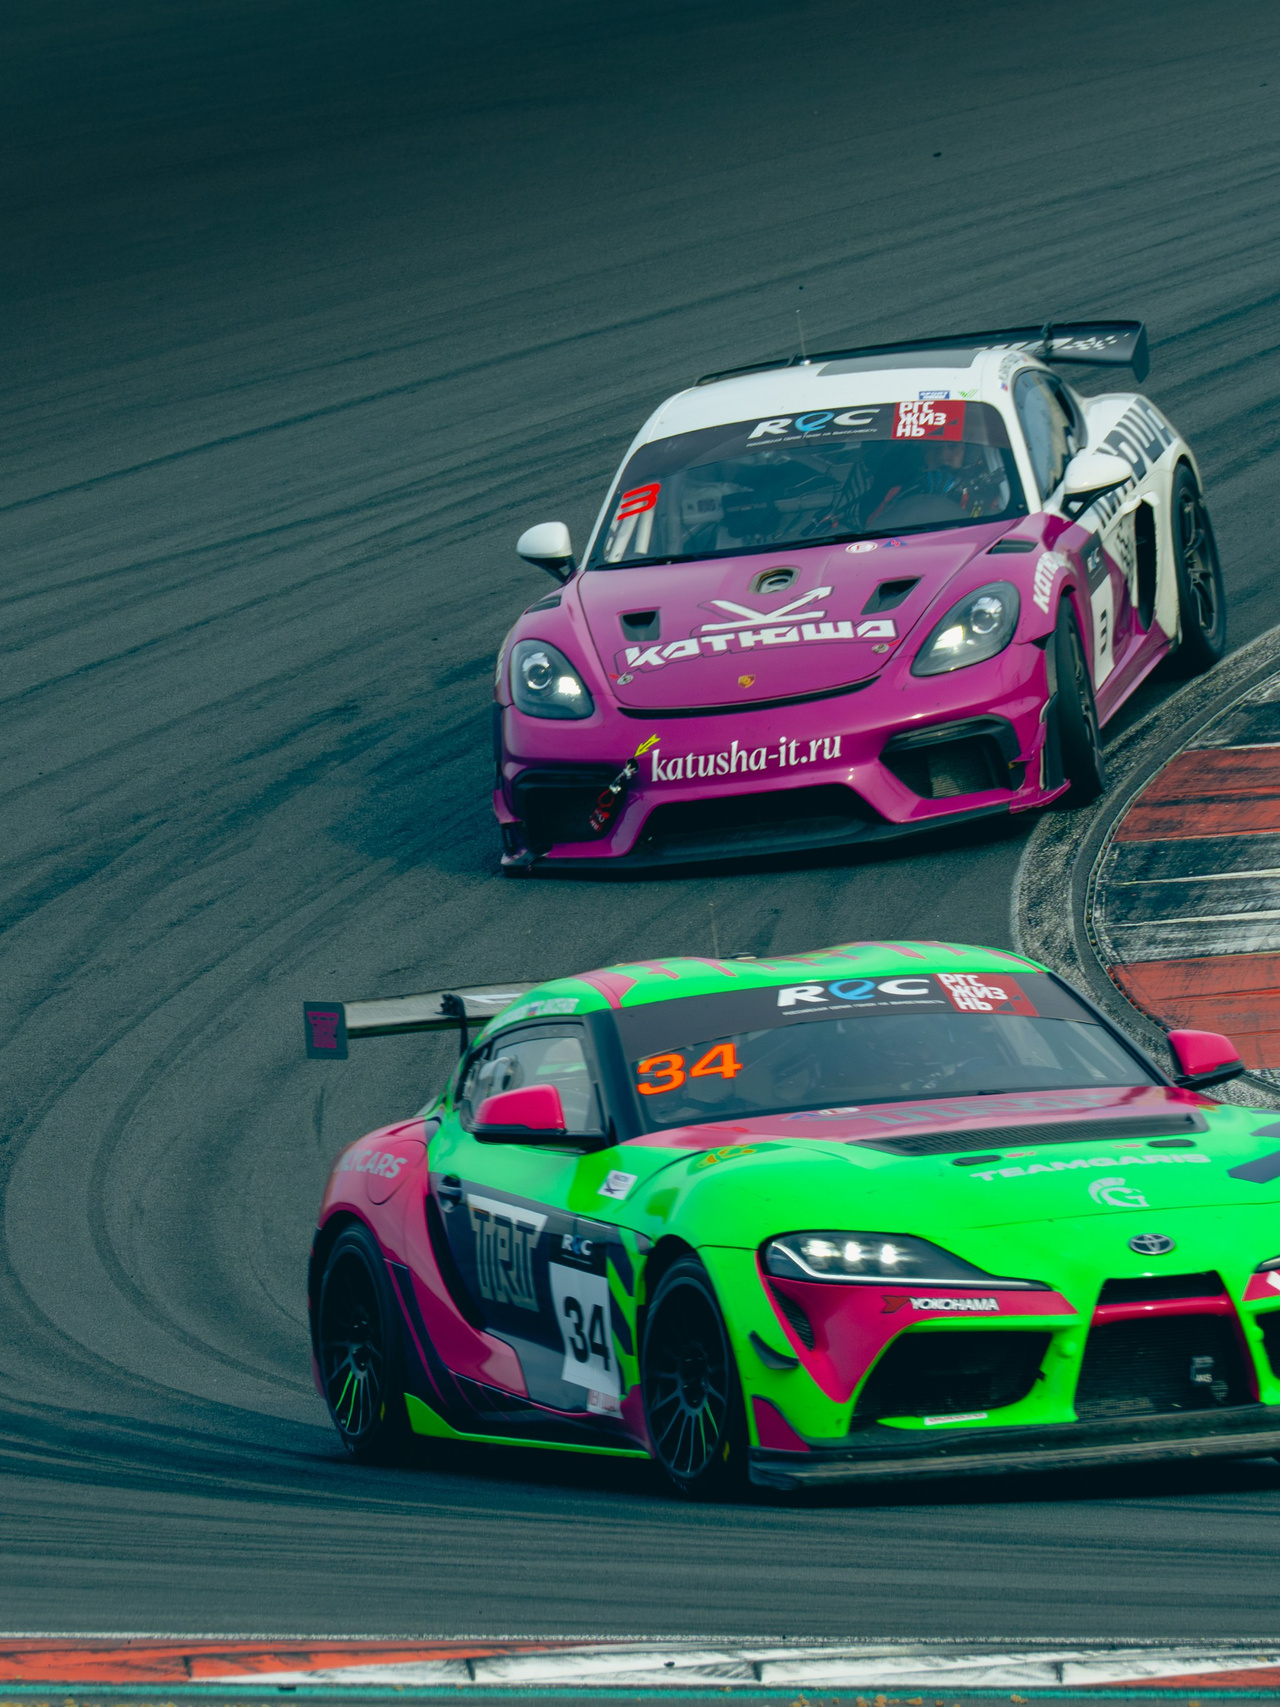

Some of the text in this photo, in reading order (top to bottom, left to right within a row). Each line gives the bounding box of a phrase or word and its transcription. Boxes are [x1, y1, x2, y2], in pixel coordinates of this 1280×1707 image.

[898, 401, 934, 413] РГС
[617, 484, 661, 521] 3
[651, 735, 842, 782] katusha-it.ru
[937, 973, 979, 987] РГС
[637, 1043, 743, 1095] 34
[909, 1297, 1000, 1311] YOKOHAMA
[564, 1296, 611, 1372] 34
